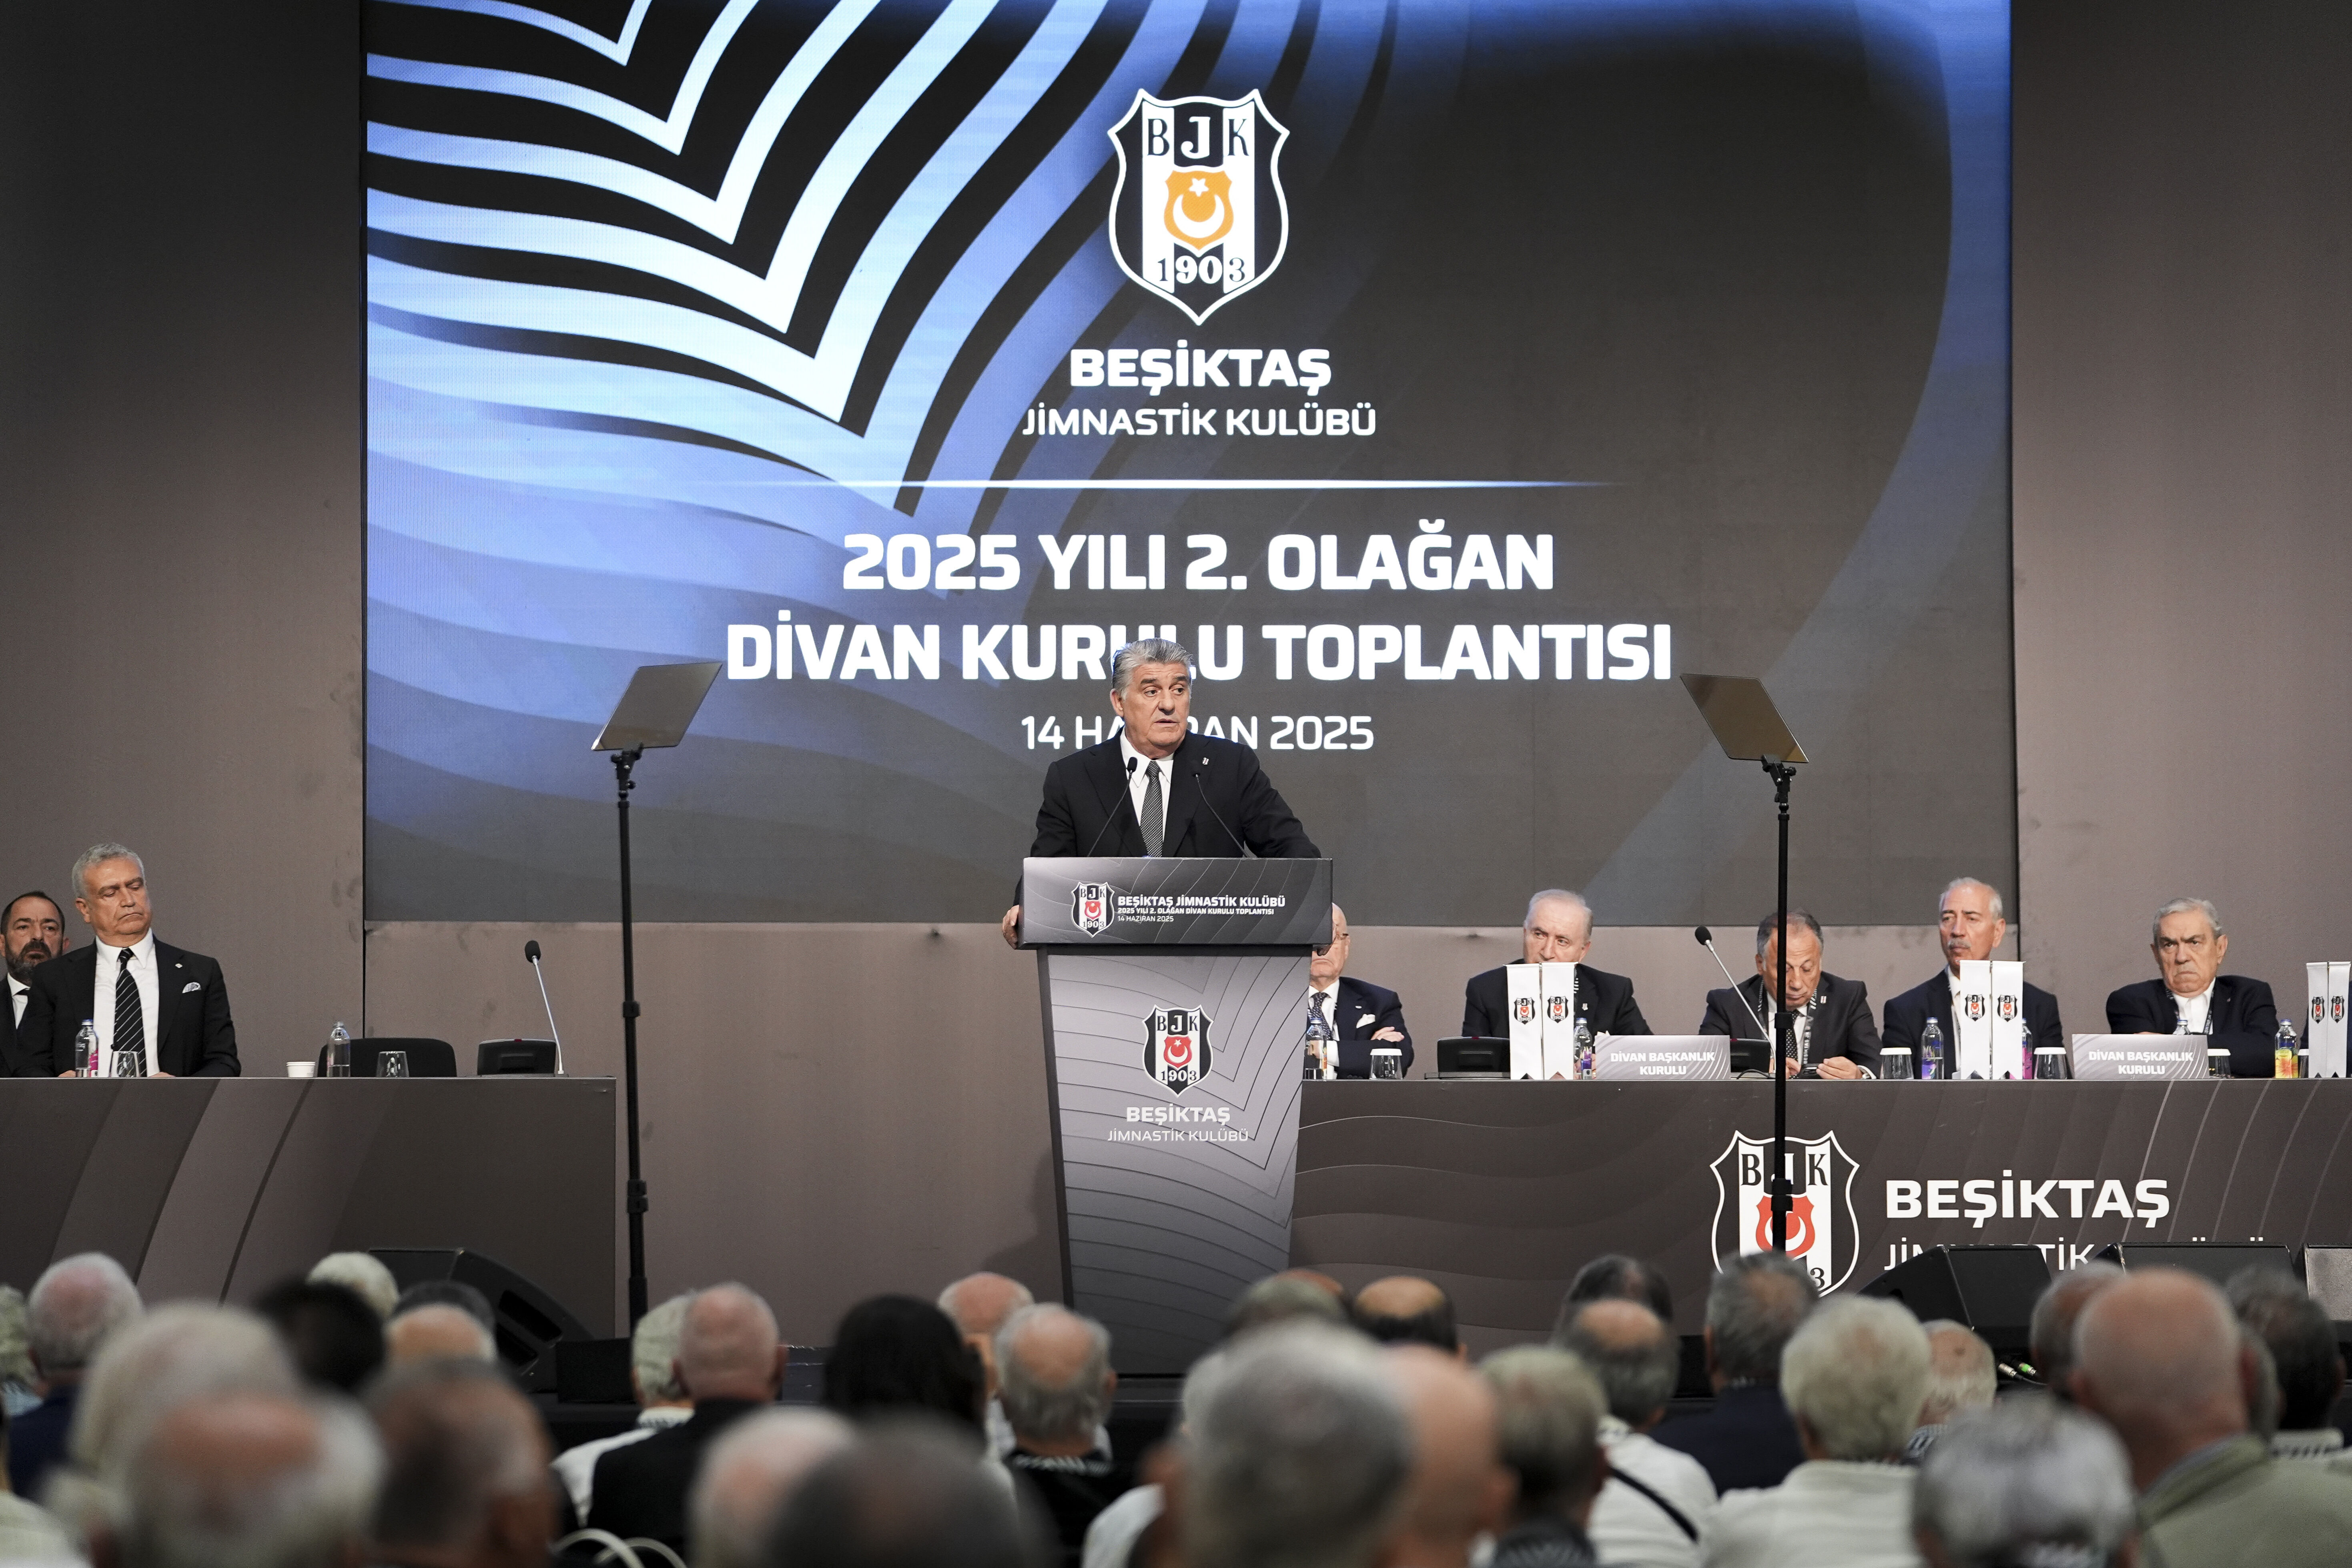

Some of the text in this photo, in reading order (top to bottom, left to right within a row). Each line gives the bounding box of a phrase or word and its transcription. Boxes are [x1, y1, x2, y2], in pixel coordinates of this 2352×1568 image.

[1147, 116, 1249, 159] BJK
[1157, 256, 1246, 285] 1903
[1070, 339, 1331, 396] BEŞİKTAŞ
[1022, 402, 1376, 435] JİMNASTİK KULÜBÜ
[843, 518, 1553, 591] 2025 YILI 2. OLAĞAN
[727, 610, 1671, 681] DİVAN KURU TOPLANTISI
[1021, 716, 1065, 750] 14
[1270, 716, 1374, 750] 2025
[1081, 888, 1105, 898] BJK
[1117, 894, 1285, 908] BEŞİKTAŞ JİMNASTİK KULÜBÜ
[1083, 920, 1105, 928] 1903
[1156, 1015, 1199, 1032] BJK
[1610, 1051, 1715, 1063] DİVAN BAŞKANLIK
[2088, 1049, 2194, 1063] DİVAN BAŞKANLIK
[1161, 1069, 1197, 1082] 1903
[1640, 1065, 1687, 1075] KURULU
[2118, 1065, 2166, 1075] KURULU
[1126, 1103, 1231, 1126] BEŞİKTAŞ
[1107, 1127, 1249, 1141] JİMNASTİK KULÜBÜ
[1886, 1169, 2170, 1228] BEŞİKTAŞ
